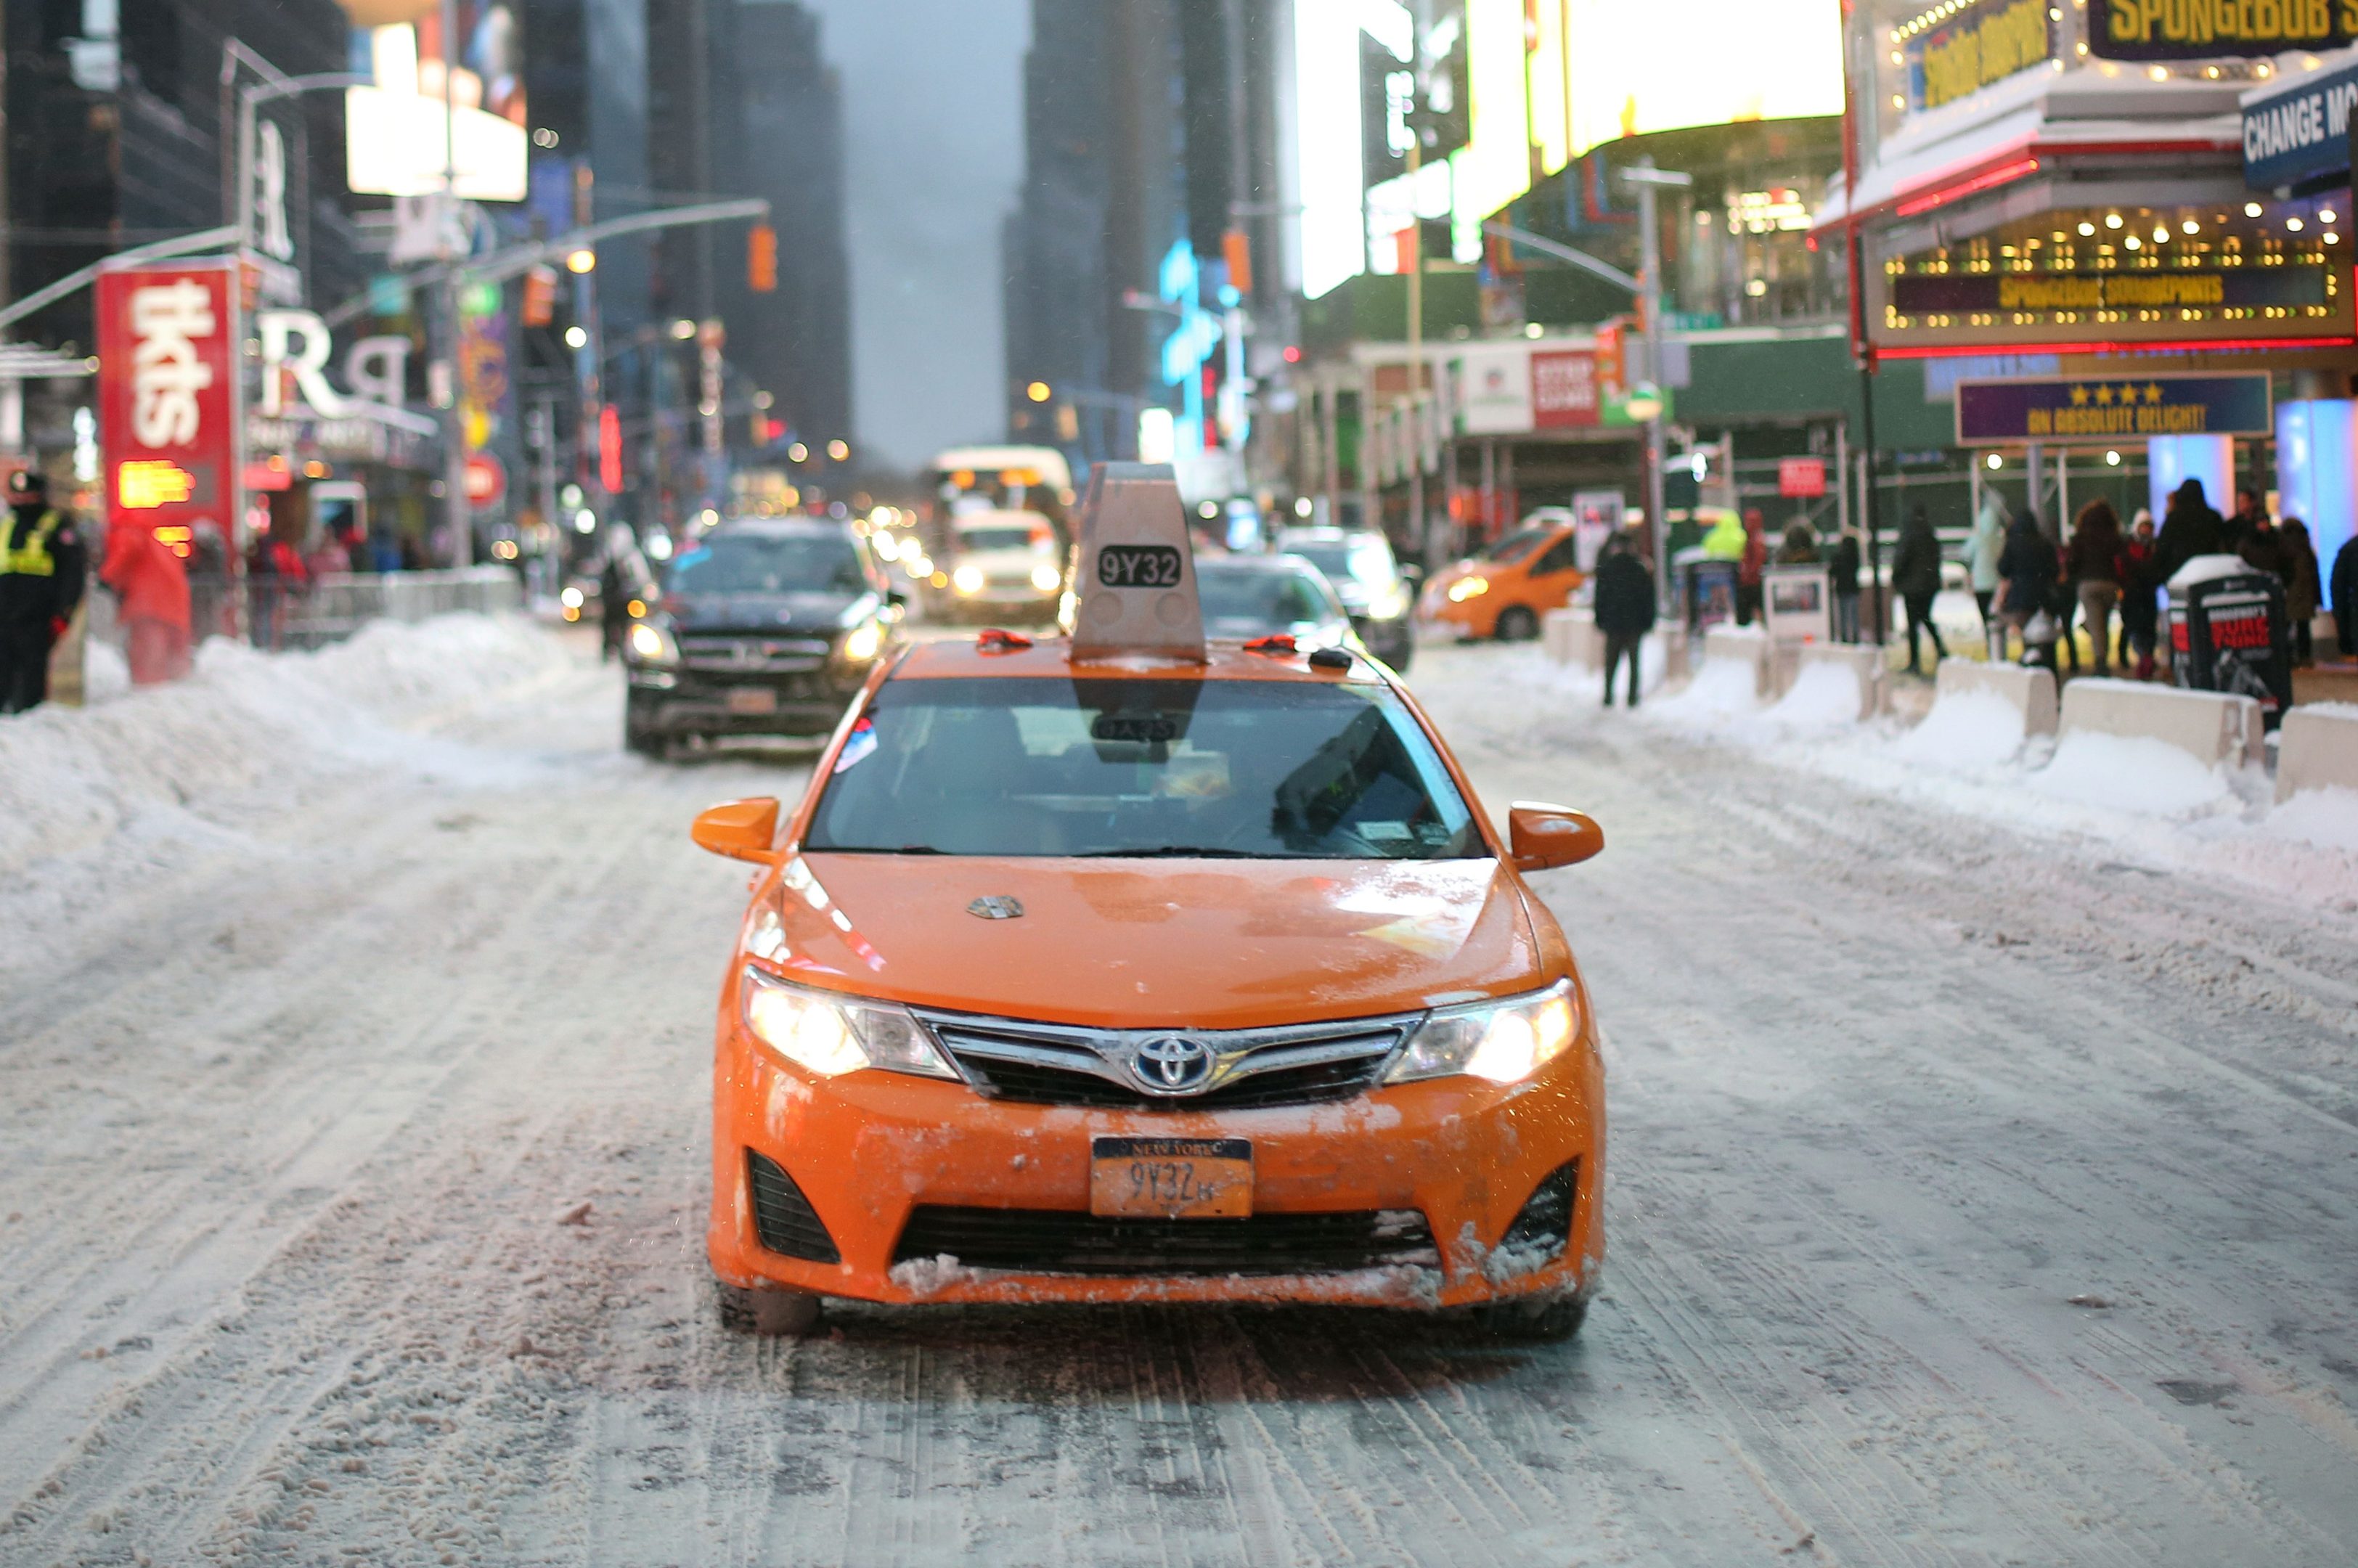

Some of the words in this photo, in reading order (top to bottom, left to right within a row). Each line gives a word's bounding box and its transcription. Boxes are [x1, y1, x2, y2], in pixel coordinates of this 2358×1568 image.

[2244, 94, 2325, 163] CHANGE
[131, 278, 215, 449] tkts
[2055, 407, 2134, 434] ABSOLUTE
[1103, 552, 1178, 584] 9Y32
[1132, 1143, 1170, 1156] NEW
[1172, 1143, 1213, 1156] YORK
